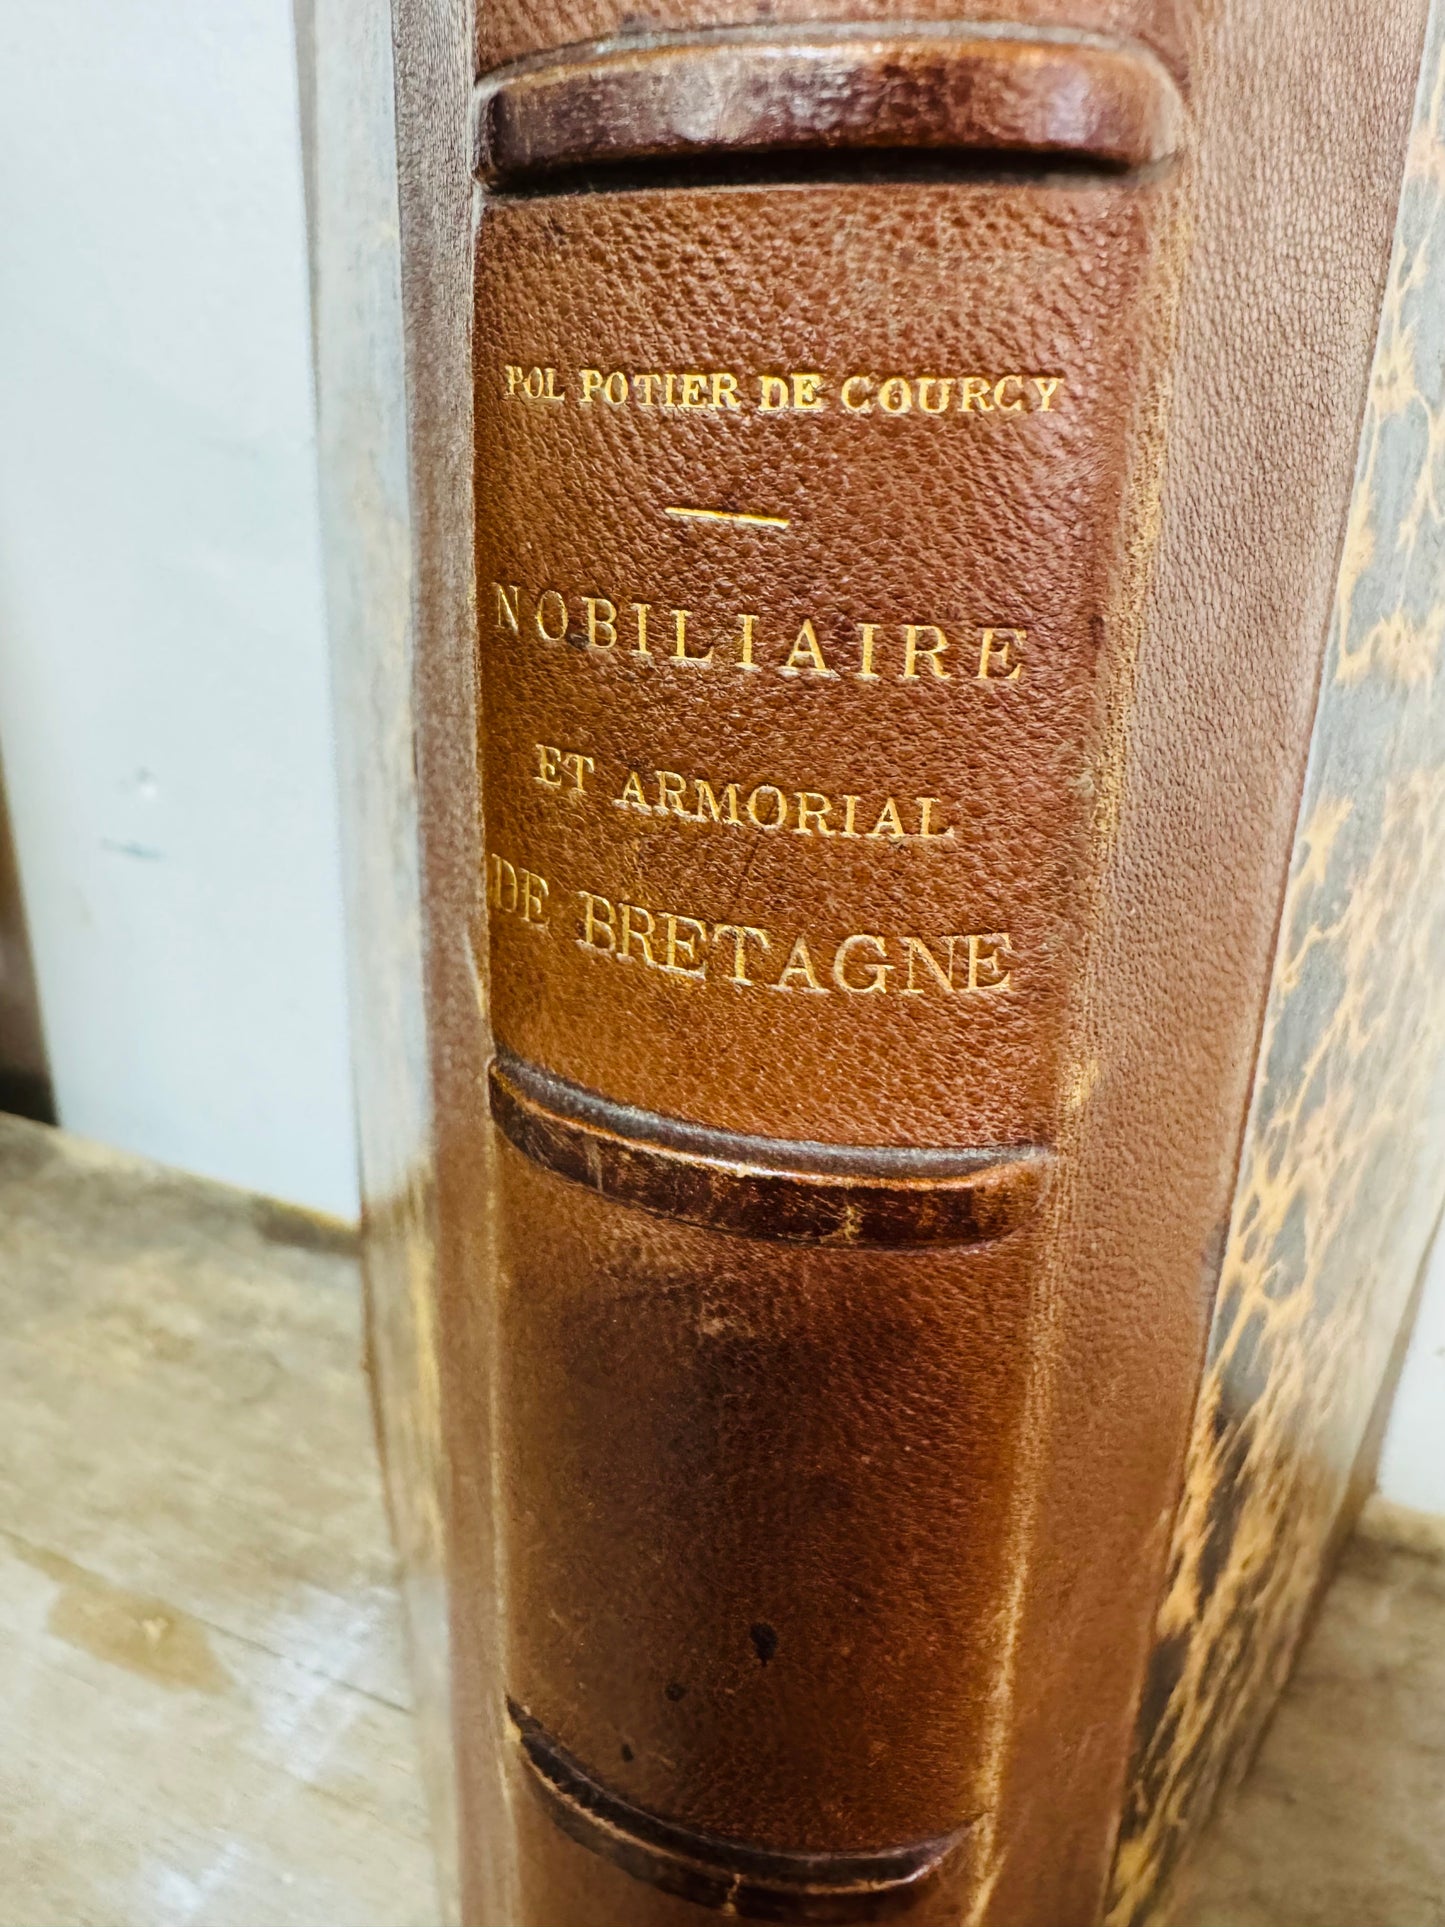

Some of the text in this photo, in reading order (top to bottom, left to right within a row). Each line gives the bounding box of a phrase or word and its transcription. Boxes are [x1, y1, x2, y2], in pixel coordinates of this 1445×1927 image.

[504, 364, 1065, 415] POL POTIER DE COURCY
[491, 582, 1027, 681] NOBILIAIRE
[533, 744, 955, 838] ET ARMORIAL
[491, 853, 1012, 994] DE BRETAGNE
